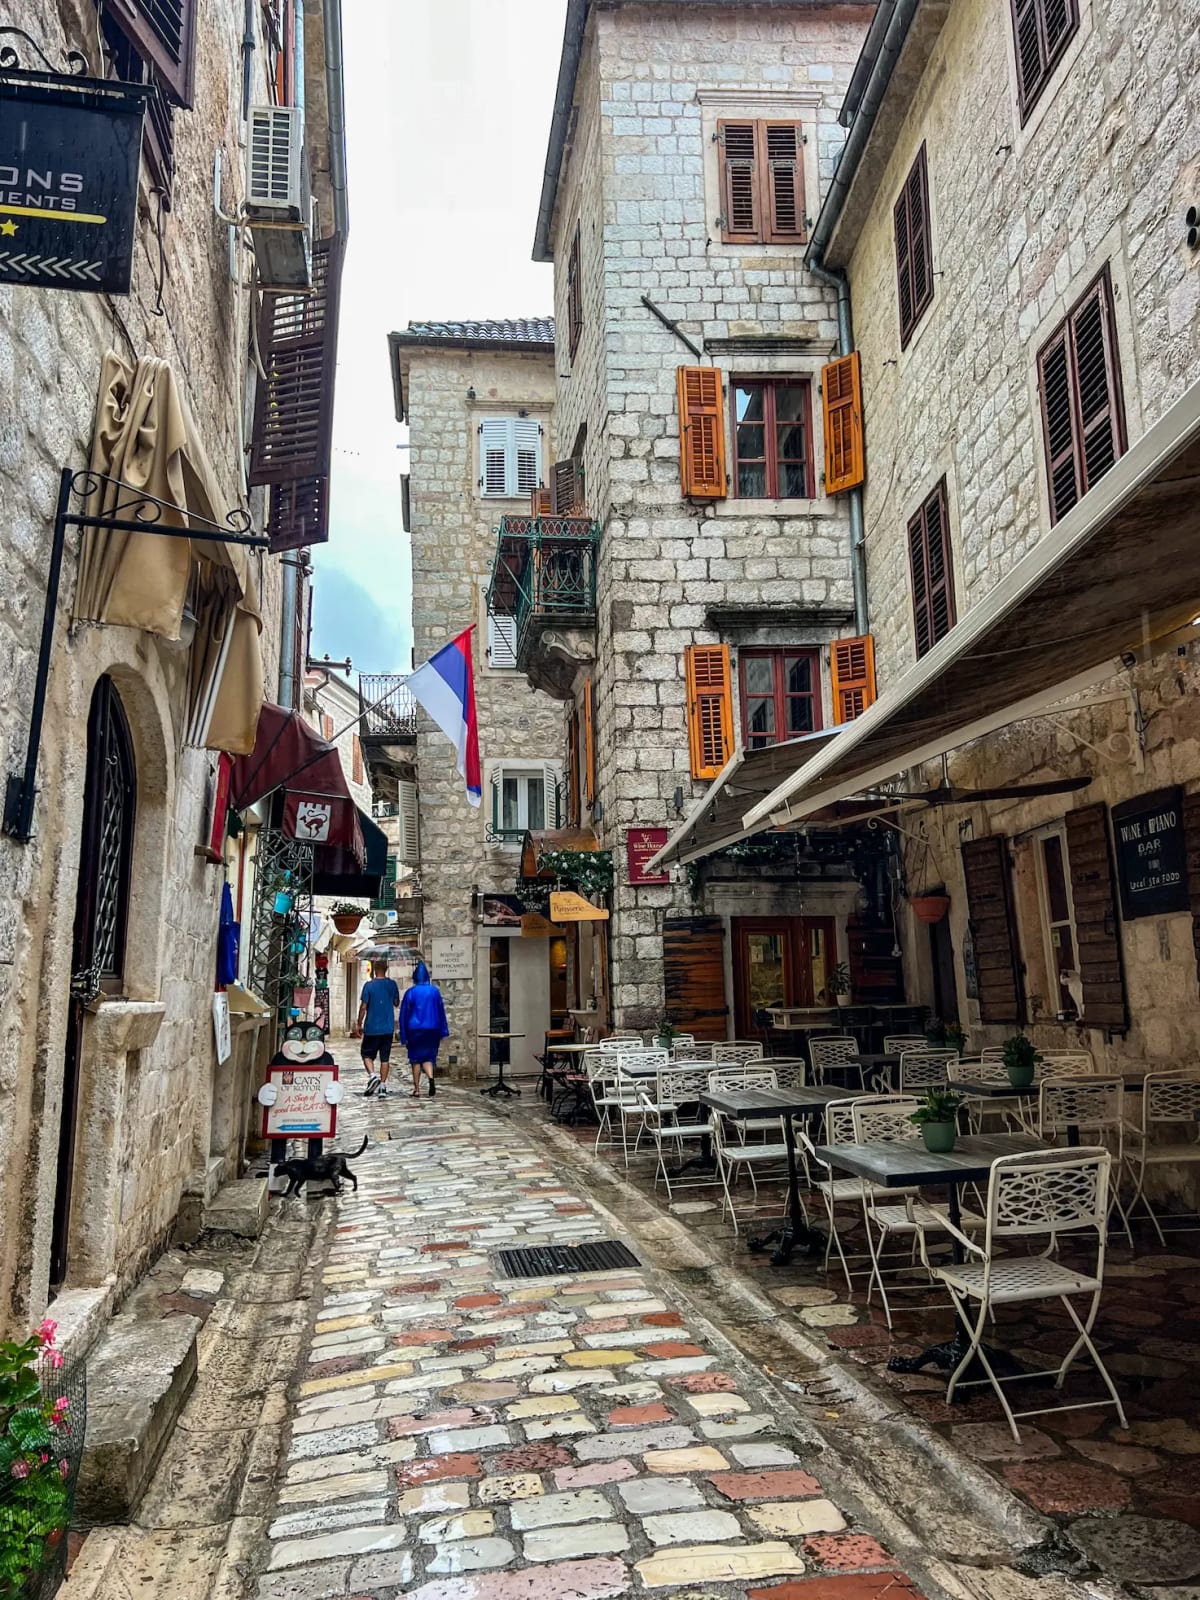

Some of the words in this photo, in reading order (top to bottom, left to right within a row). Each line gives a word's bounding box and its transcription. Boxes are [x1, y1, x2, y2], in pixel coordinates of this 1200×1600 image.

[1120, 822, 1142, 842] WINE
[1148, 811, 1176, 834] PIANO
[1138, 838, 1161, 853] BAR
[1162, 872, 1180, 883] FOOD
[294, 1076, 321, 1085] CATS
